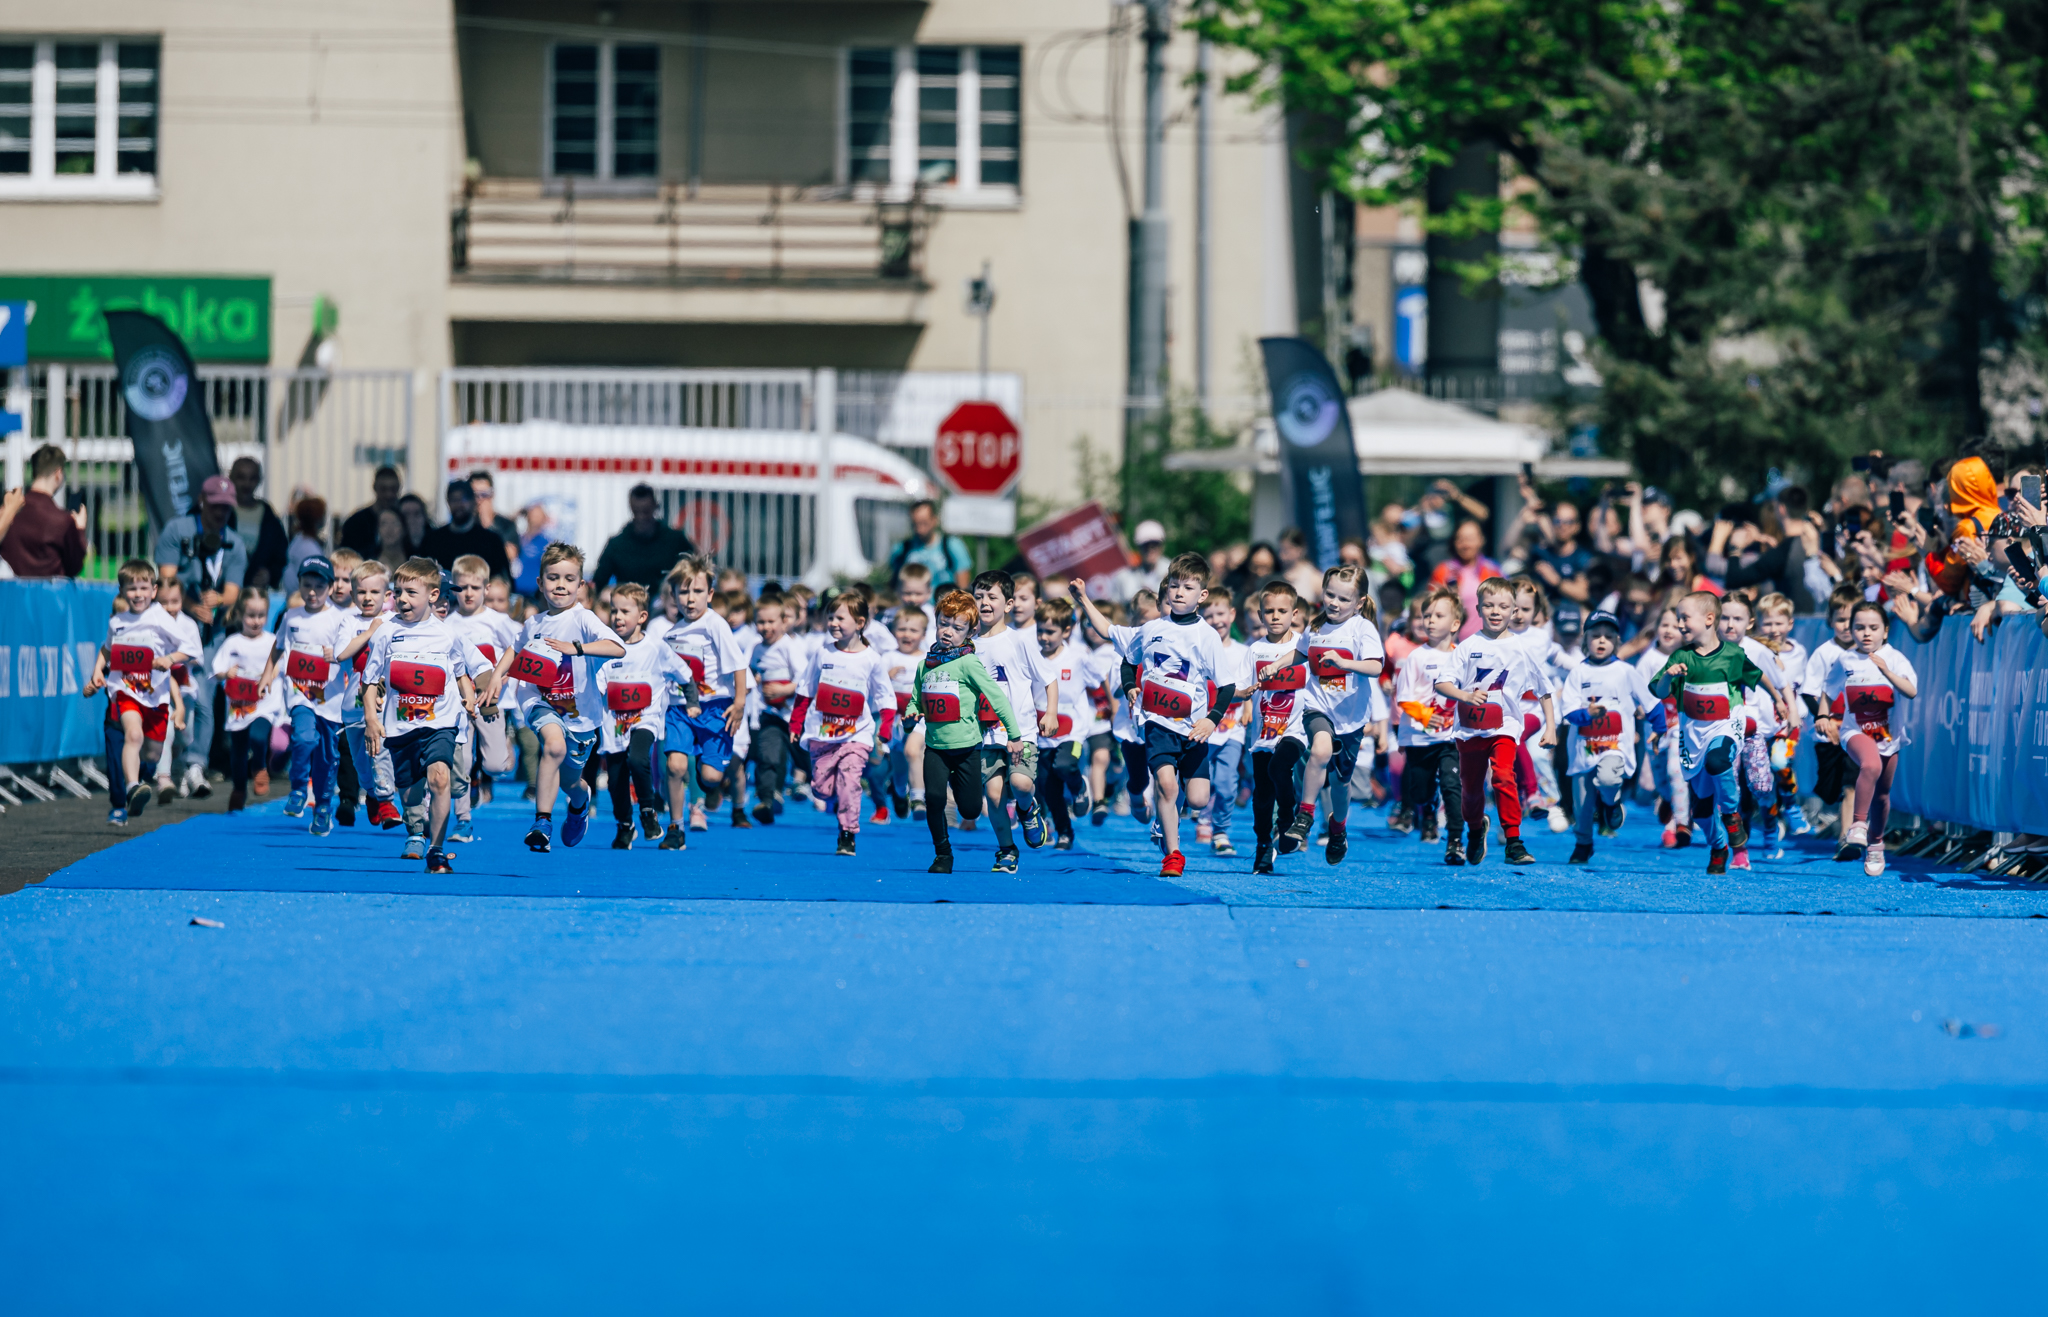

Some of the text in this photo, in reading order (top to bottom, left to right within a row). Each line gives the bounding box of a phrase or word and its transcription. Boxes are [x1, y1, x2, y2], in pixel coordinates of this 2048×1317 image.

[68, 284, 258, 346] żbka
[939, 431, 1018, 470] STOP
[120, 650, 145, 664] 189
[298, 658, 316, 673] 96
[518, 656, 544, 677] 132
[413, 670, 425, 686] 5
[1270, 667, 1296, 683] 42
[621, 688, 641, 703] 56
[831, 692, 851, 708] 55
[1153, 691, 1180, 711] 146
[1858, 690, 1879, 706] 36
[926, 699, 946, 715] 178
[1468, 708, 1486, 722] 47
[1696, 700, 1715, 714] 52
[1590, 716, 1611, 730] 191
